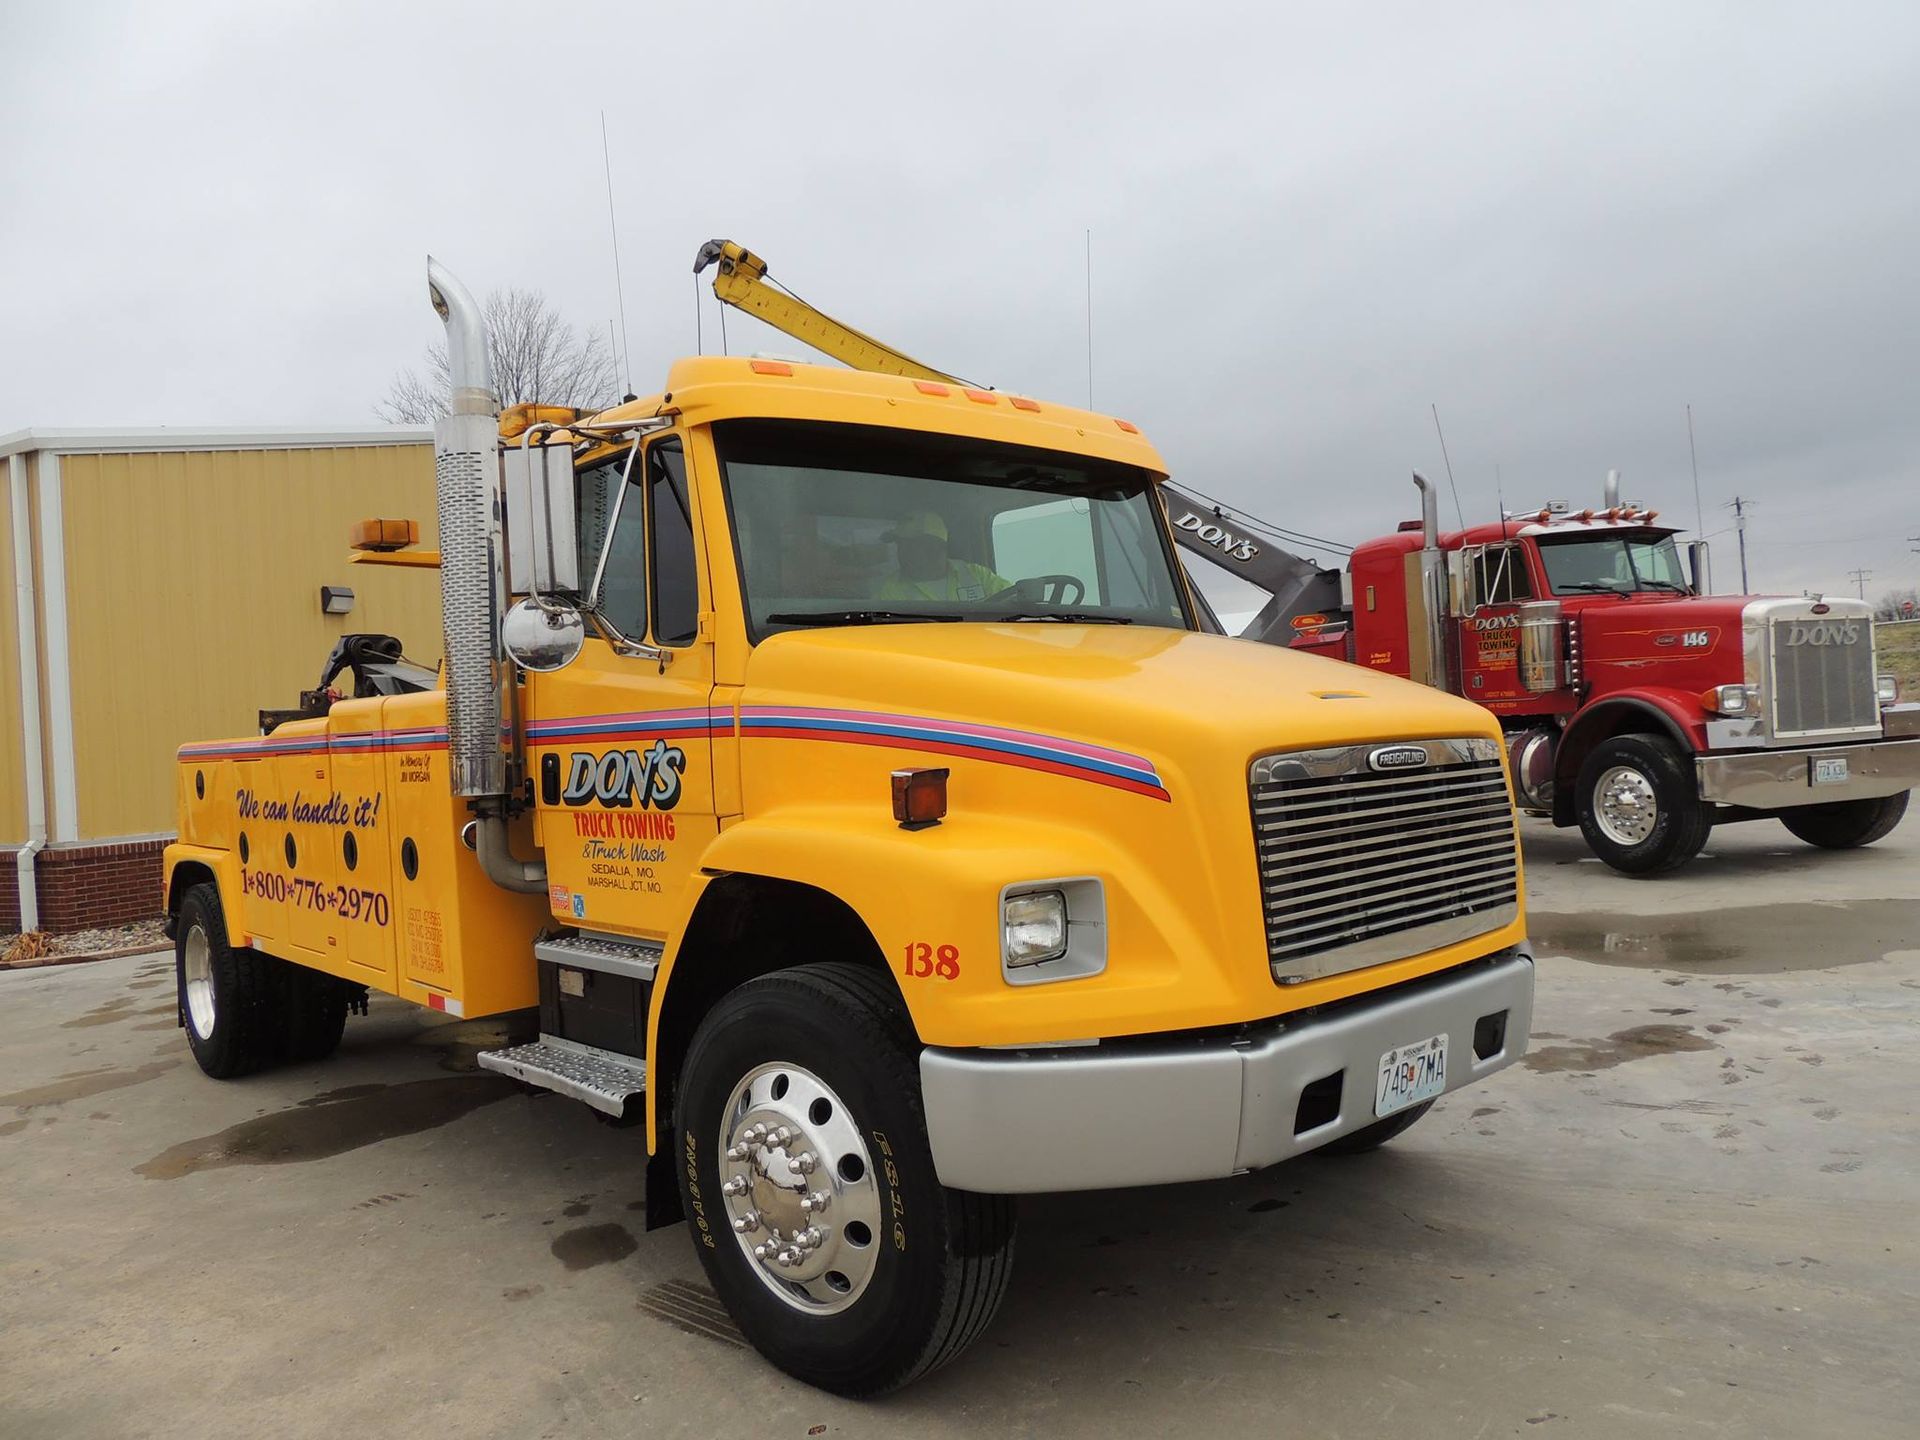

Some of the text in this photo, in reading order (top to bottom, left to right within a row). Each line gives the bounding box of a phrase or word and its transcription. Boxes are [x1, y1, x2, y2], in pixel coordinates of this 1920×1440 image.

[1173, 512, 1259, 562] DON'S
[1476, 613, 1520, 632] DON'S
[1479, 640, 1516, 651] TOWING
[1482, 630, 1511, 640] TRUCK
[1682, 631, 1709, 647] 146
[1785, 624, 1859, 647] DON'S
[1380, 751, 1425, 765] FREIGHTLINER
[562, 739, 687, 811] DON'S
[236, 788, 381, 828] We can handle it!
[573, 812, 676, 841] TRUCK TOWING
[588, 840, 629, 860] Truck
[630, 842, 667, 862] Wash
[587, 877, 628, 890] MARSHALL
[904, 942, 960, 981] 138
[685, 1130, 716, 1249] ROADONE
